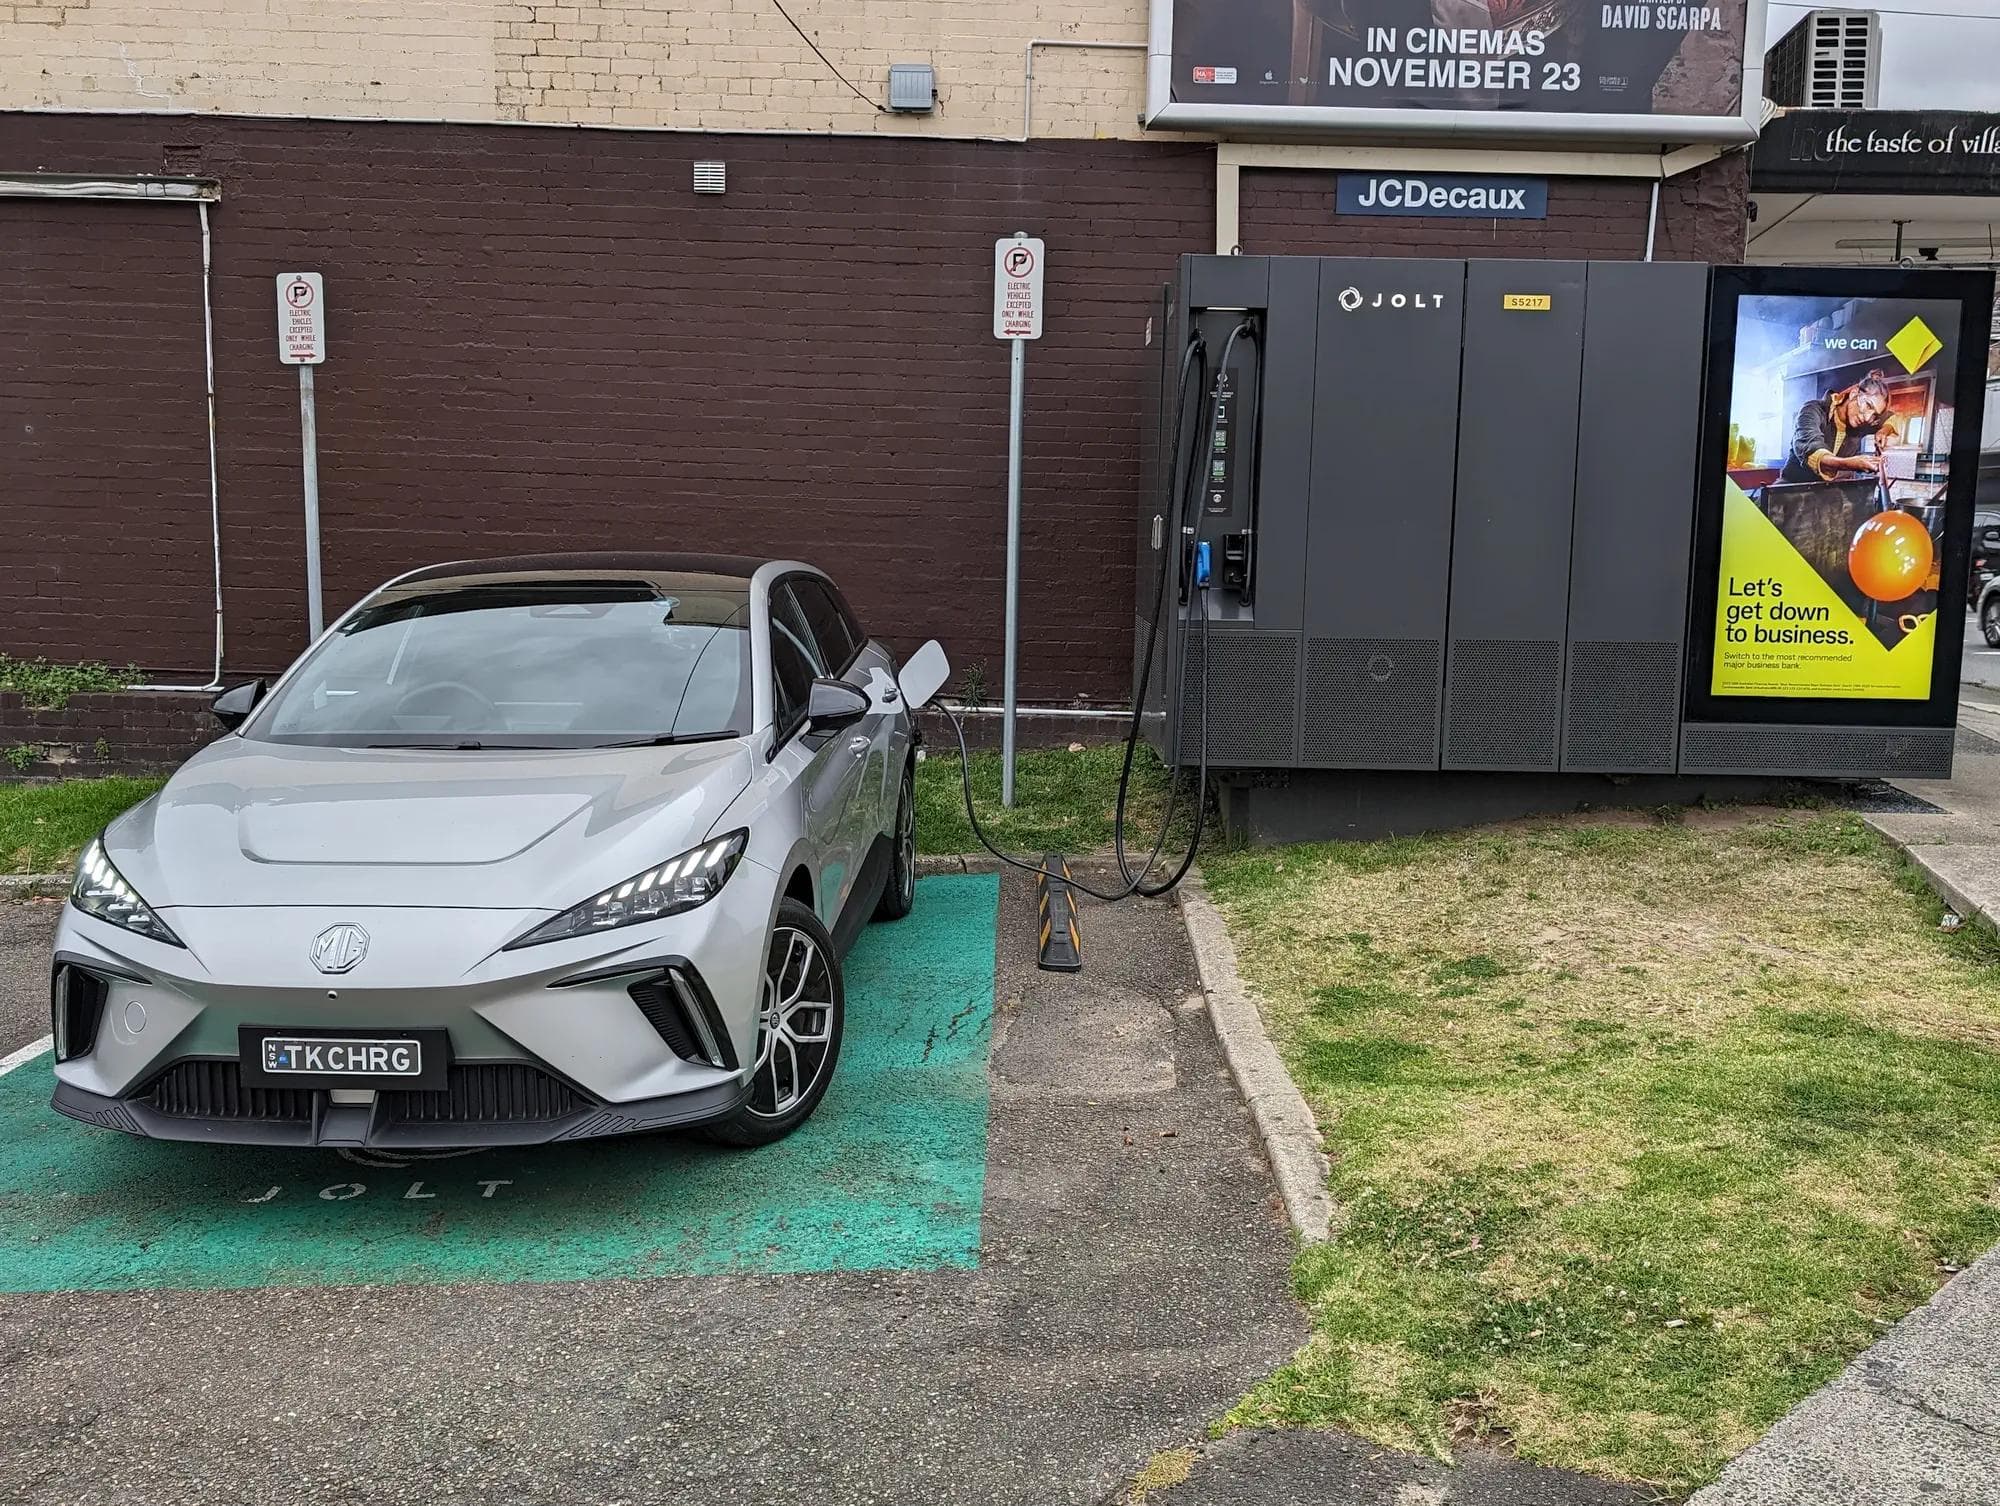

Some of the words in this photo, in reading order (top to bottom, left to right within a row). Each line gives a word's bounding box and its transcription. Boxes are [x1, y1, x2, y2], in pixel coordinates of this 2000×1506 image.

[1601, 4, 1650, 29] DAVID
[1655, 5, 1722, 31] SCARPA
[1367, 27, 1397, 53] IN
[1406, 27, 1545, 56] CINEMAS
[1329, 57, 1531, 90] NOVEMBER
[1541, 62, 1581, 91] 23
[1826, 124, 1862, 153] the
[1866, 129, 1922, 153] taste
[1927, 125, 1958, 154] of
[1358, 178, 1526, 210] JCDecaux
[1007, 282, 1031, 290] ELECTRIC
[1007, 291, 1031, 299] VEHICLES
[1372, 293, 1444, 308] JOLT
[1006, 301, 1032, 309] EXCEPTED
[1511, 297, 1543, 307] S5217
[1002, 310, 1015, 318] ONLY
[1018, 310, 1034, 318] WHILE
[289, 326, 313, 334] EXCEPTED
[1005, 320, 1031, 328] CHARGING
[286, 334, 298, 342] ONLY
[301, 334, 316, 342] WHILE
[1824, 338, 1847, 350] we
[1850, 338, 1878, 350] can
[289, 343, 314, 351] CHARGING
[1729, 577, 1783, 597] Let's
[1727, 601, 1763, 624] get
[1770, 601, 1830, 621] down
[1725, 624, 1748, 643] to
[1754, 624, 1854, 645] business.
[1724, 651, 1750, 660] Switch
[1752, 652, 1760, 660] to
[1762, 653, 1774, 661] the
[1776, 653, 1796, 661] most
[1797, 654, 1853, 662] recommended
[1723, 661, 1746, 670] major
[1747, 660, 1780, 669] business
[1781, 661, 1802, 670] bank.
[315, 926, 364, 969] MG
[284, 1045, 411, 1072] TKCHRG
[241, 1179, 514, 1203] JOLT
